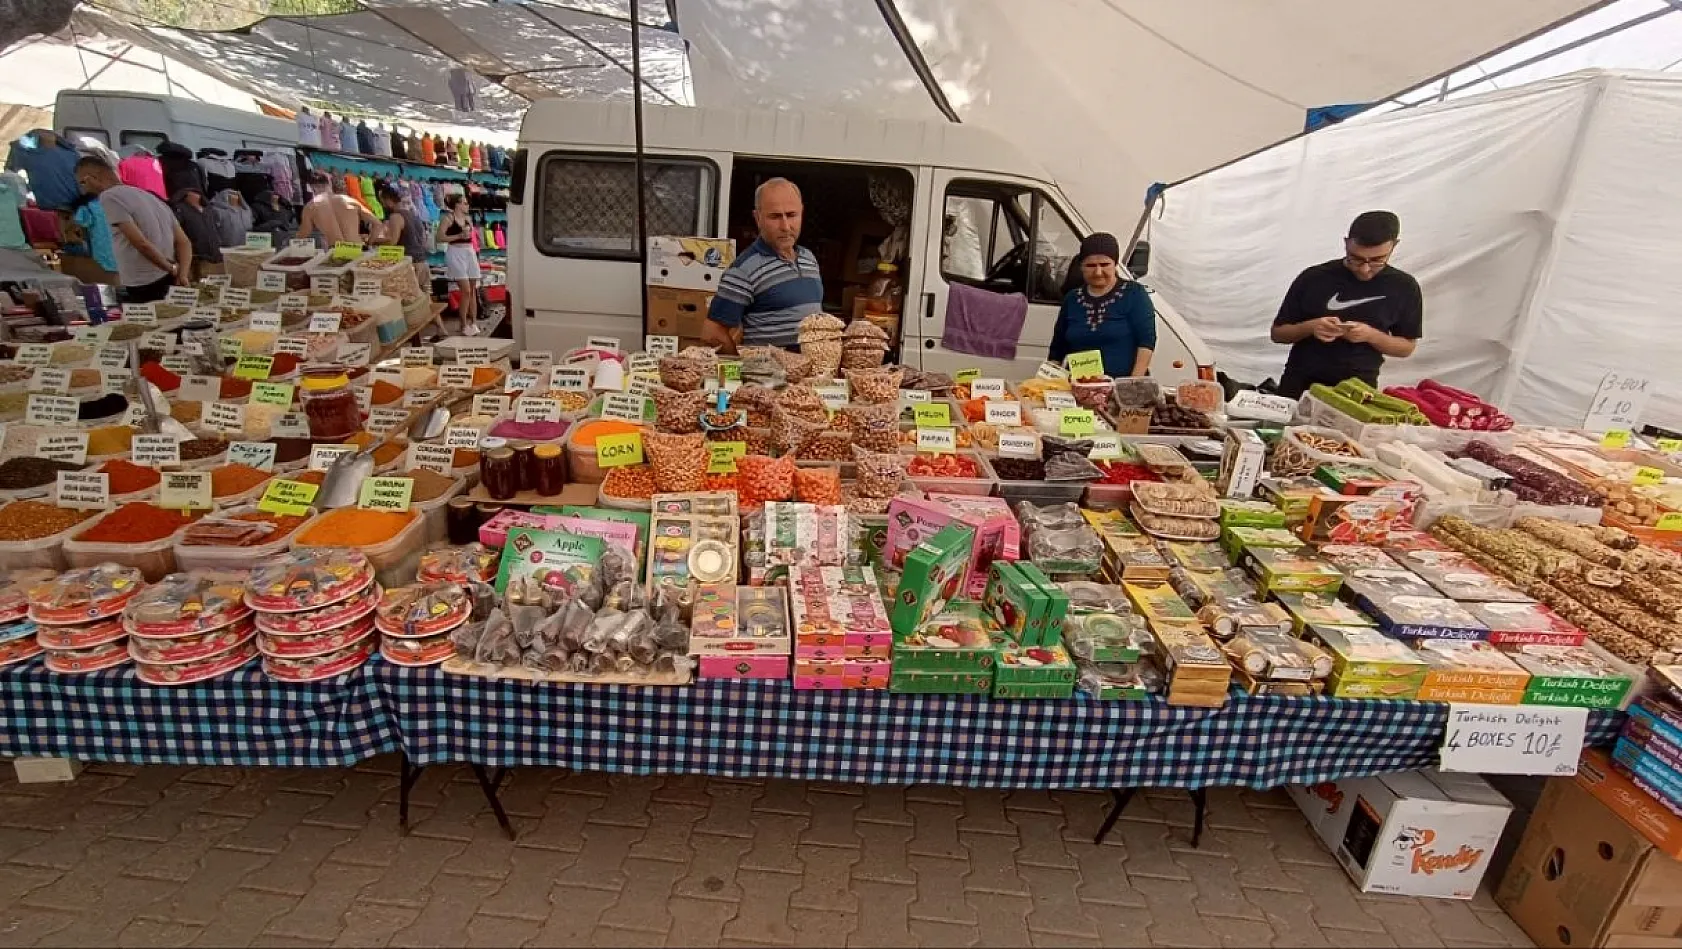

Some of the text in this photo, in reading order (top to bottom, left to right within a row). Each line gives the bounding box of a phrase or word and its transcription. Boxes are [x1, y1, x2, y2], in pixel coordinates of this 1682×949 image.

[917, 410, 944, 418] MELON
[989, 410, 1016, 418] GINGER
[1064, 415, 1091, 425] POMELO
[449, 428, 477, 438] INDIAN
[446, 437, 476, 446] CURRY
[602, 443, 635, 459] CORN
[552, 536, 586, 552] Apple
[1400, 625, 1481, 641] Turkish Delight
[1498, 631, 1576, 646] Turkish Delight
[1436, 673, 1519, 687] Turkish Delight
[1541, 677, 1622, 692] Turkish Delight
[1428, 688, 1514, 703] Turkish Delight
[1532, 691, 1614, 707] Turkish Delight
[1455, 710, 1562, 726] Turkish Delight
[1448, 728, 1462, 752] 4
[1467, 731, 1516, 748] BOXES
